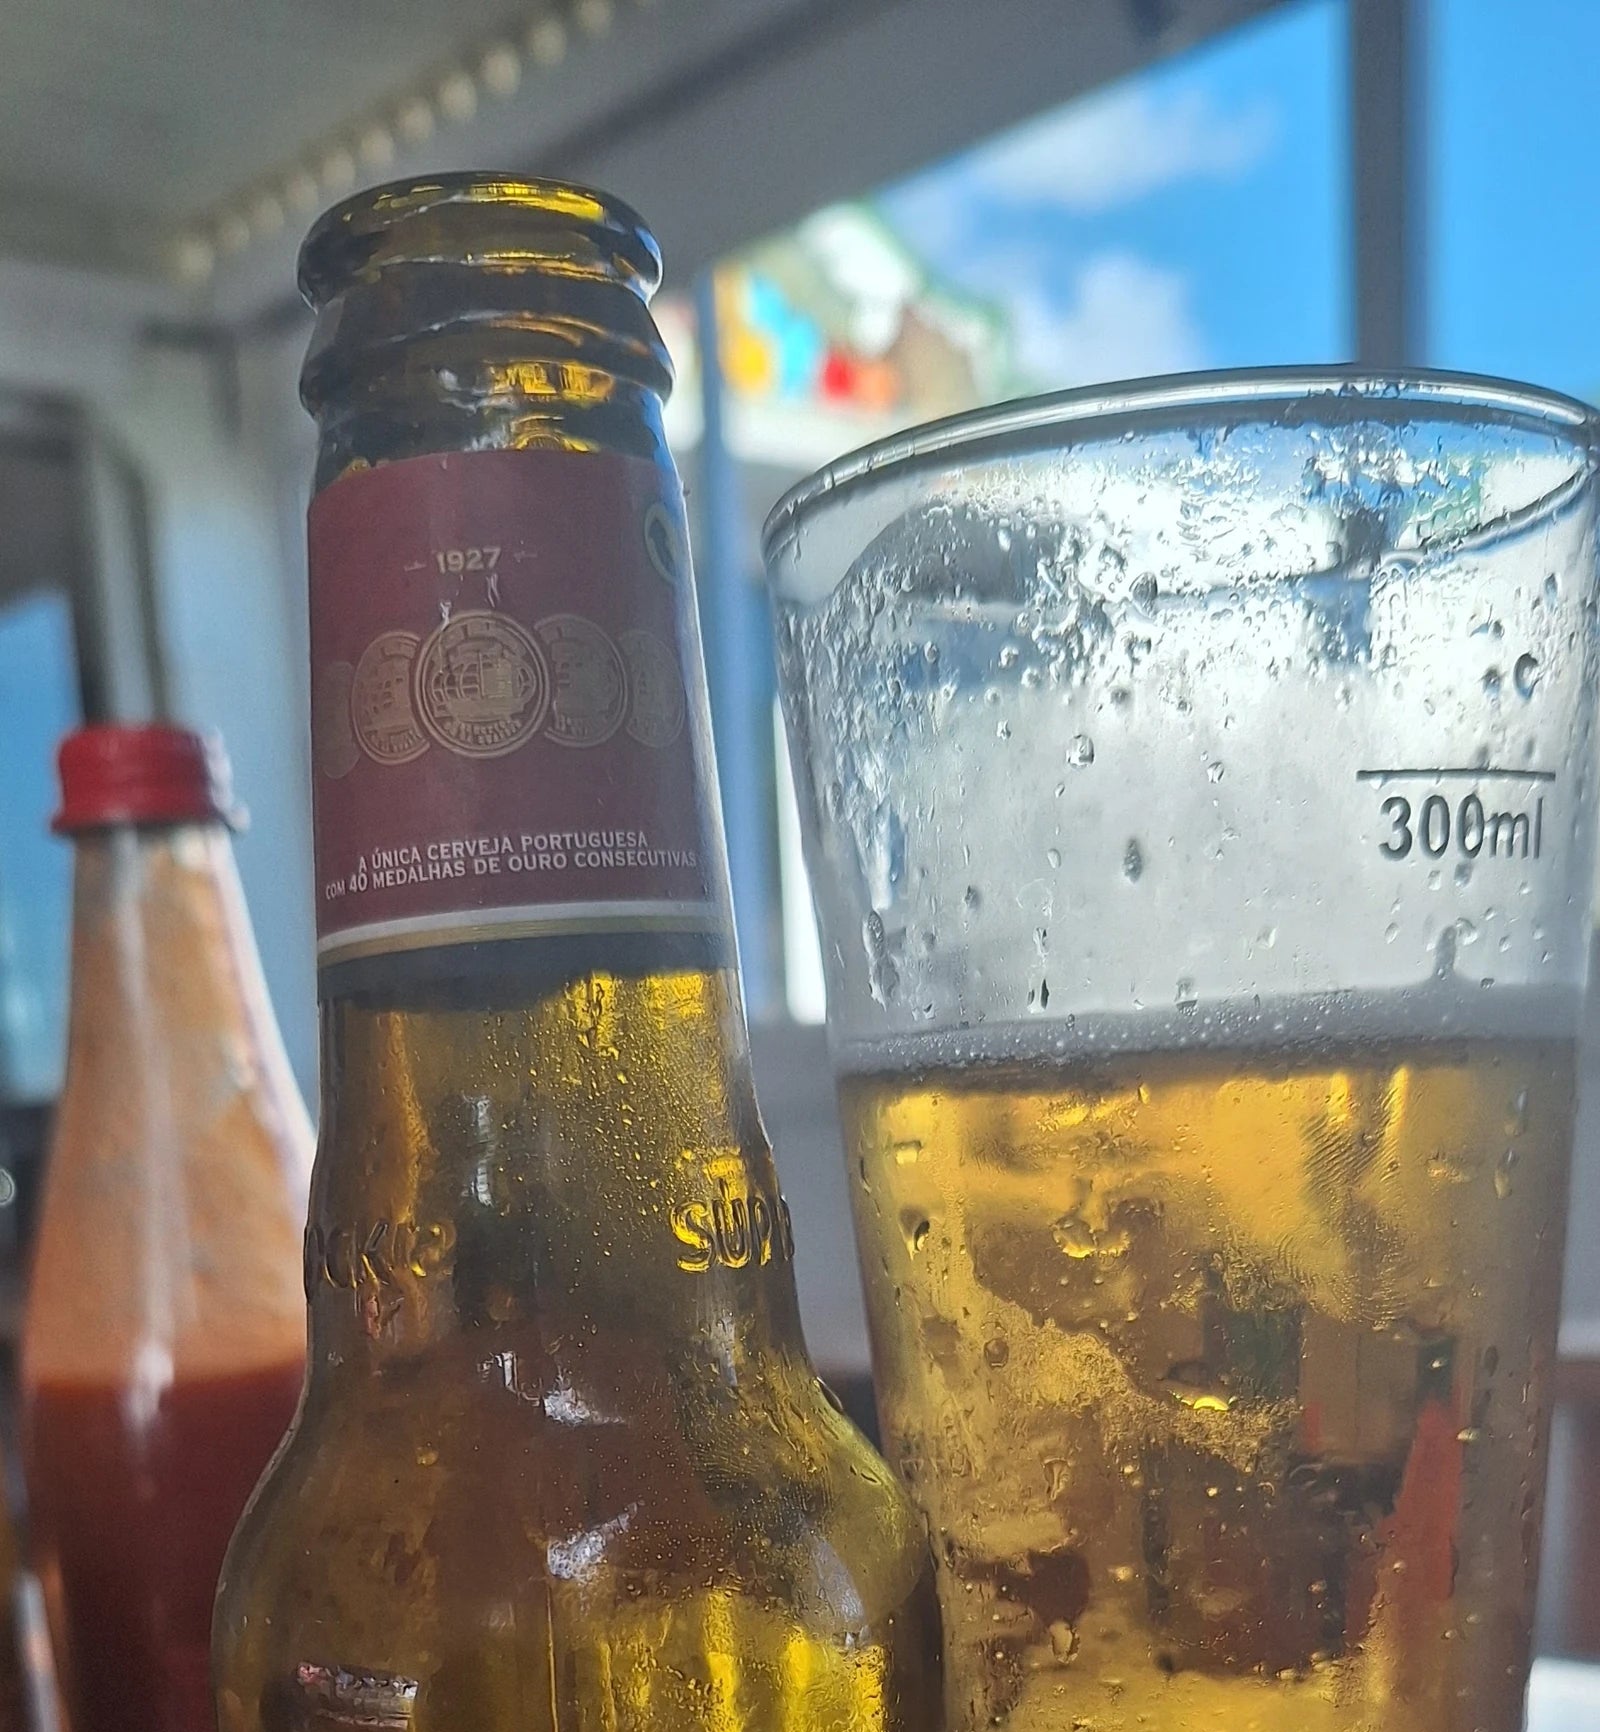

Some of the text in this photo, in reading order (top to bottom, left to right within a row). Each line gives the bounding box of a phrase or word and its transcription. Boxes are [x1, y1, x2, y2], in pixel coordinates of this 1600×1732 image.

[436, 547, 501, 575] 1927
[1378, 793, 1544, 861] 300ml
[325, 850, 697, 900] COM 40 MEDALHAS DE OURO CONSECUTIVAS
[357, 830, 648, 874] A ÚNICA CERVEJA PORTUGUESA
